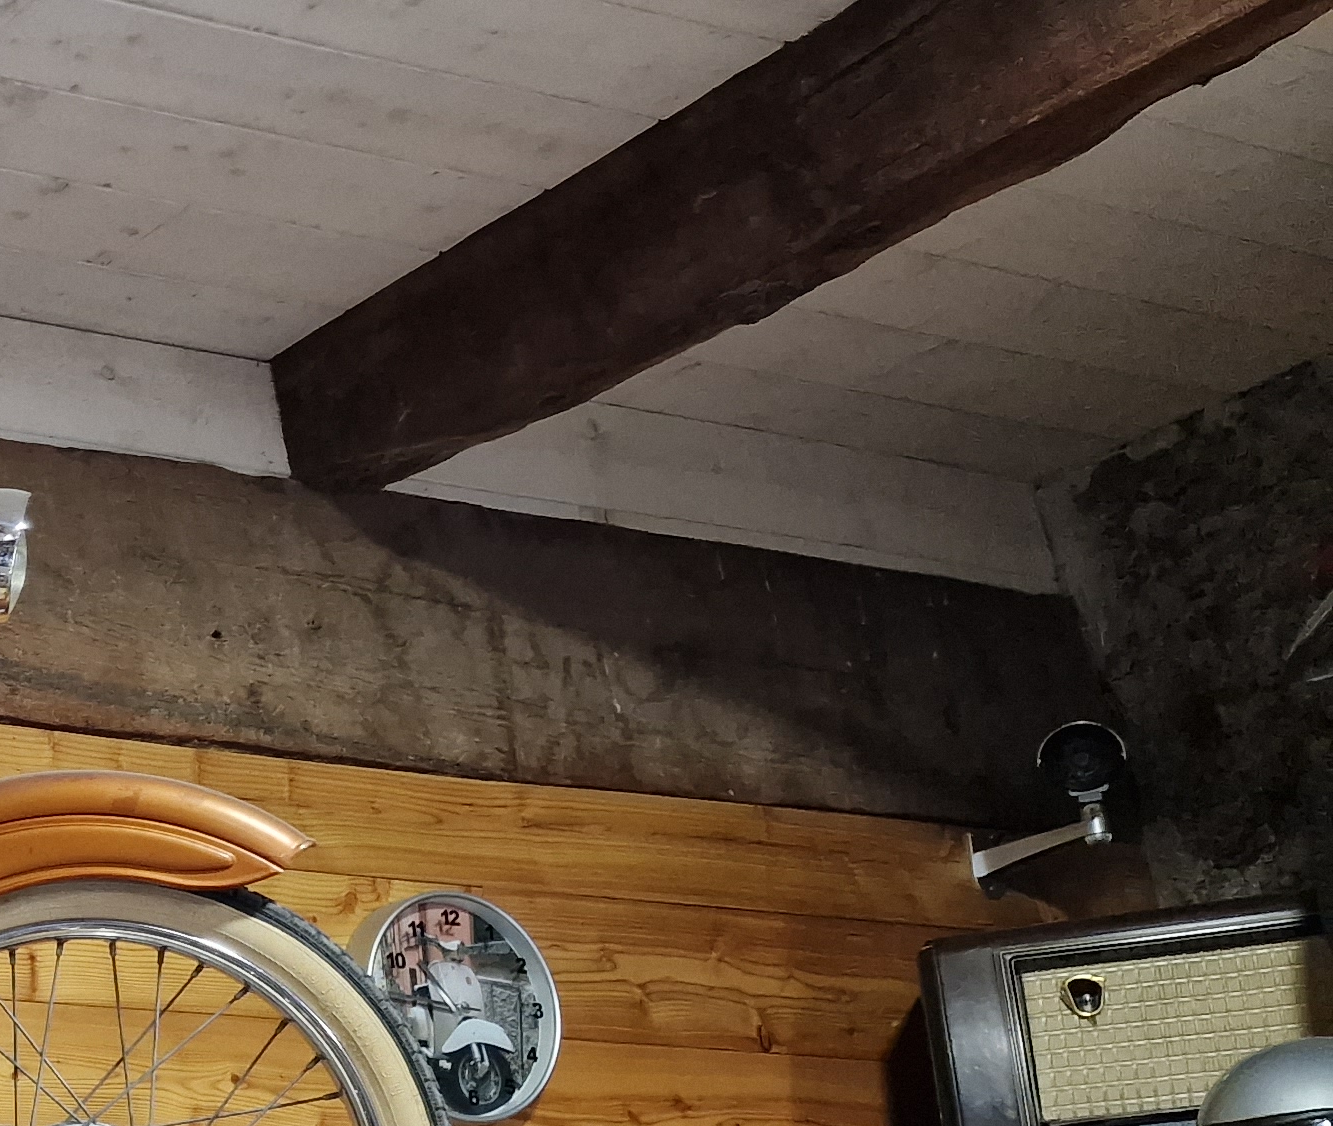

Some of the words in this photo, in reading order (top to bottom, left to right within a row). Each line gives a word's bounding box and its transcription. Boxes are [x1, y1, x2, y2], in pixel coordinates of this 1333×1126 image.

[441, 909, 461, 927] 12
[408, 921, 425, 937] 11
[387, 952, 407, 969] 10
[516, 957, 528, 975] 2
[526, 1047, 539, 1063] 4
[468, 1090, 480, 1105] 6
